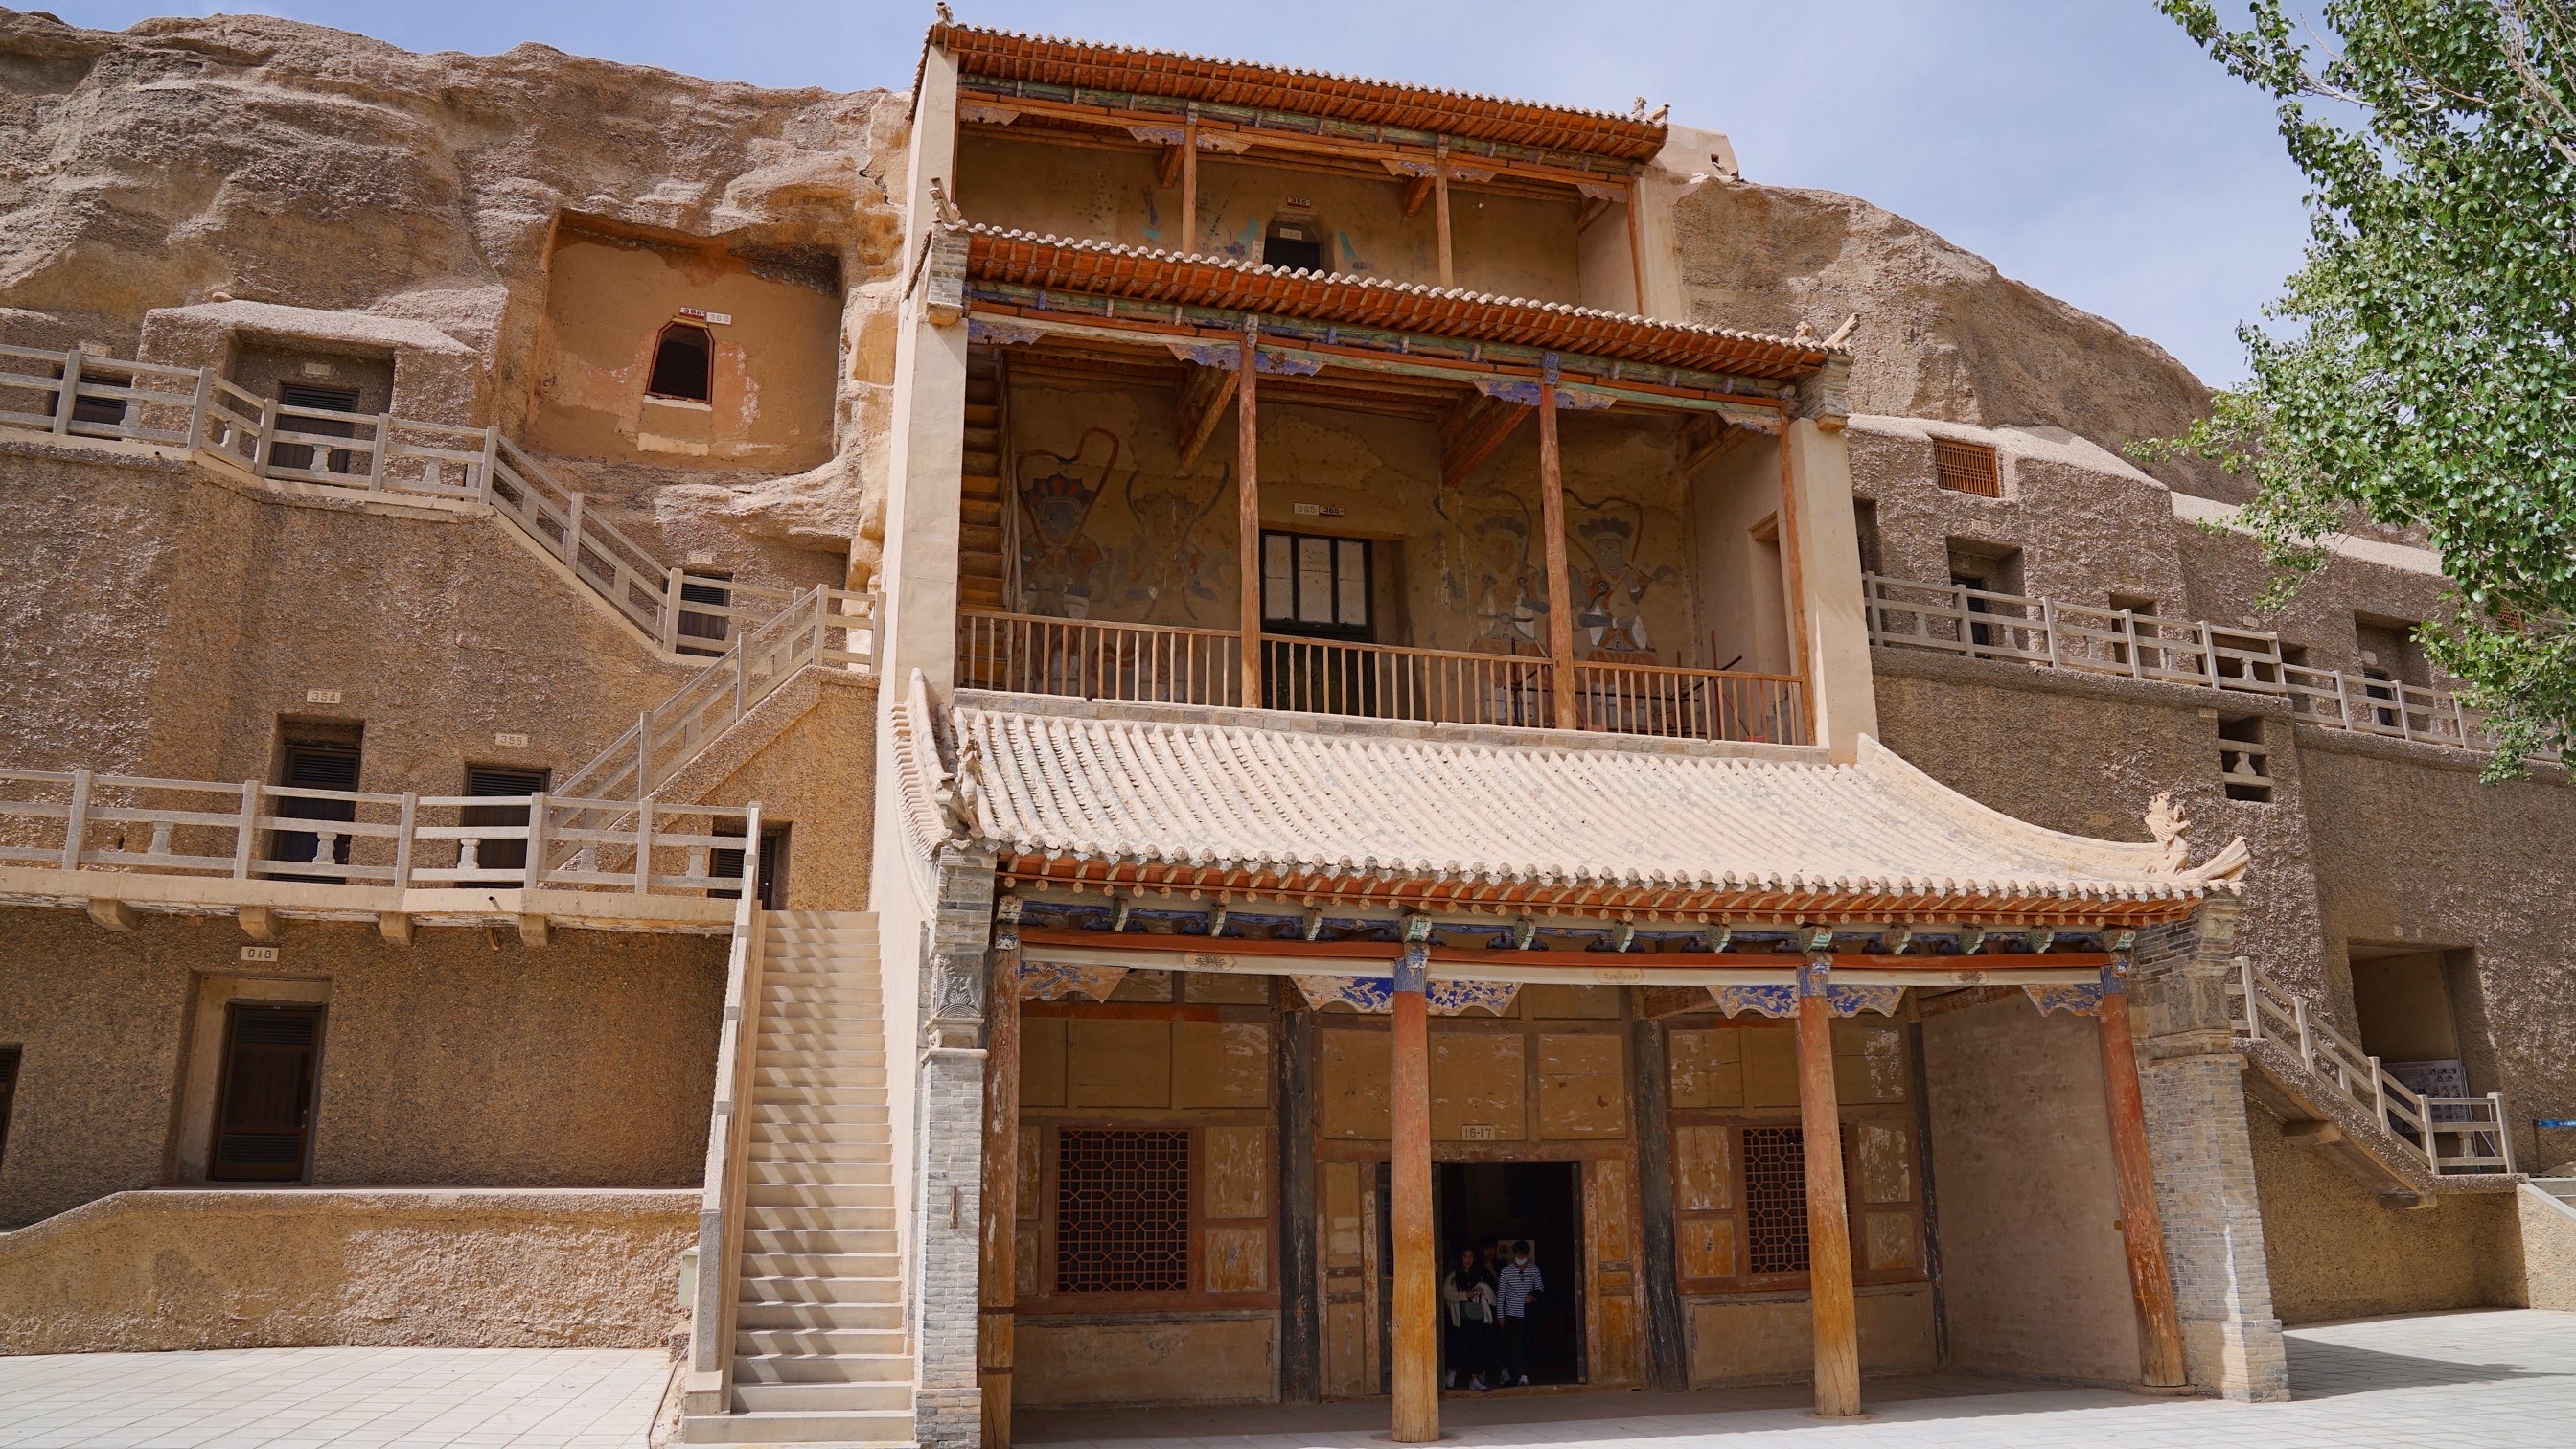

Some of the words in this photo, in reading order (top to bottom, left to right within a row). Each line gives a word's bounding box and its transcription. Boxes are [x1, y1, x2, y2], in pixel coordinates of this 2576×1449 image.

[312, 691, 336, 701] 354
[500, 735, 522, 745] 355
[248, 949, 271, 959] 018
[1465, 1127, 1492, 1138] 16-17
